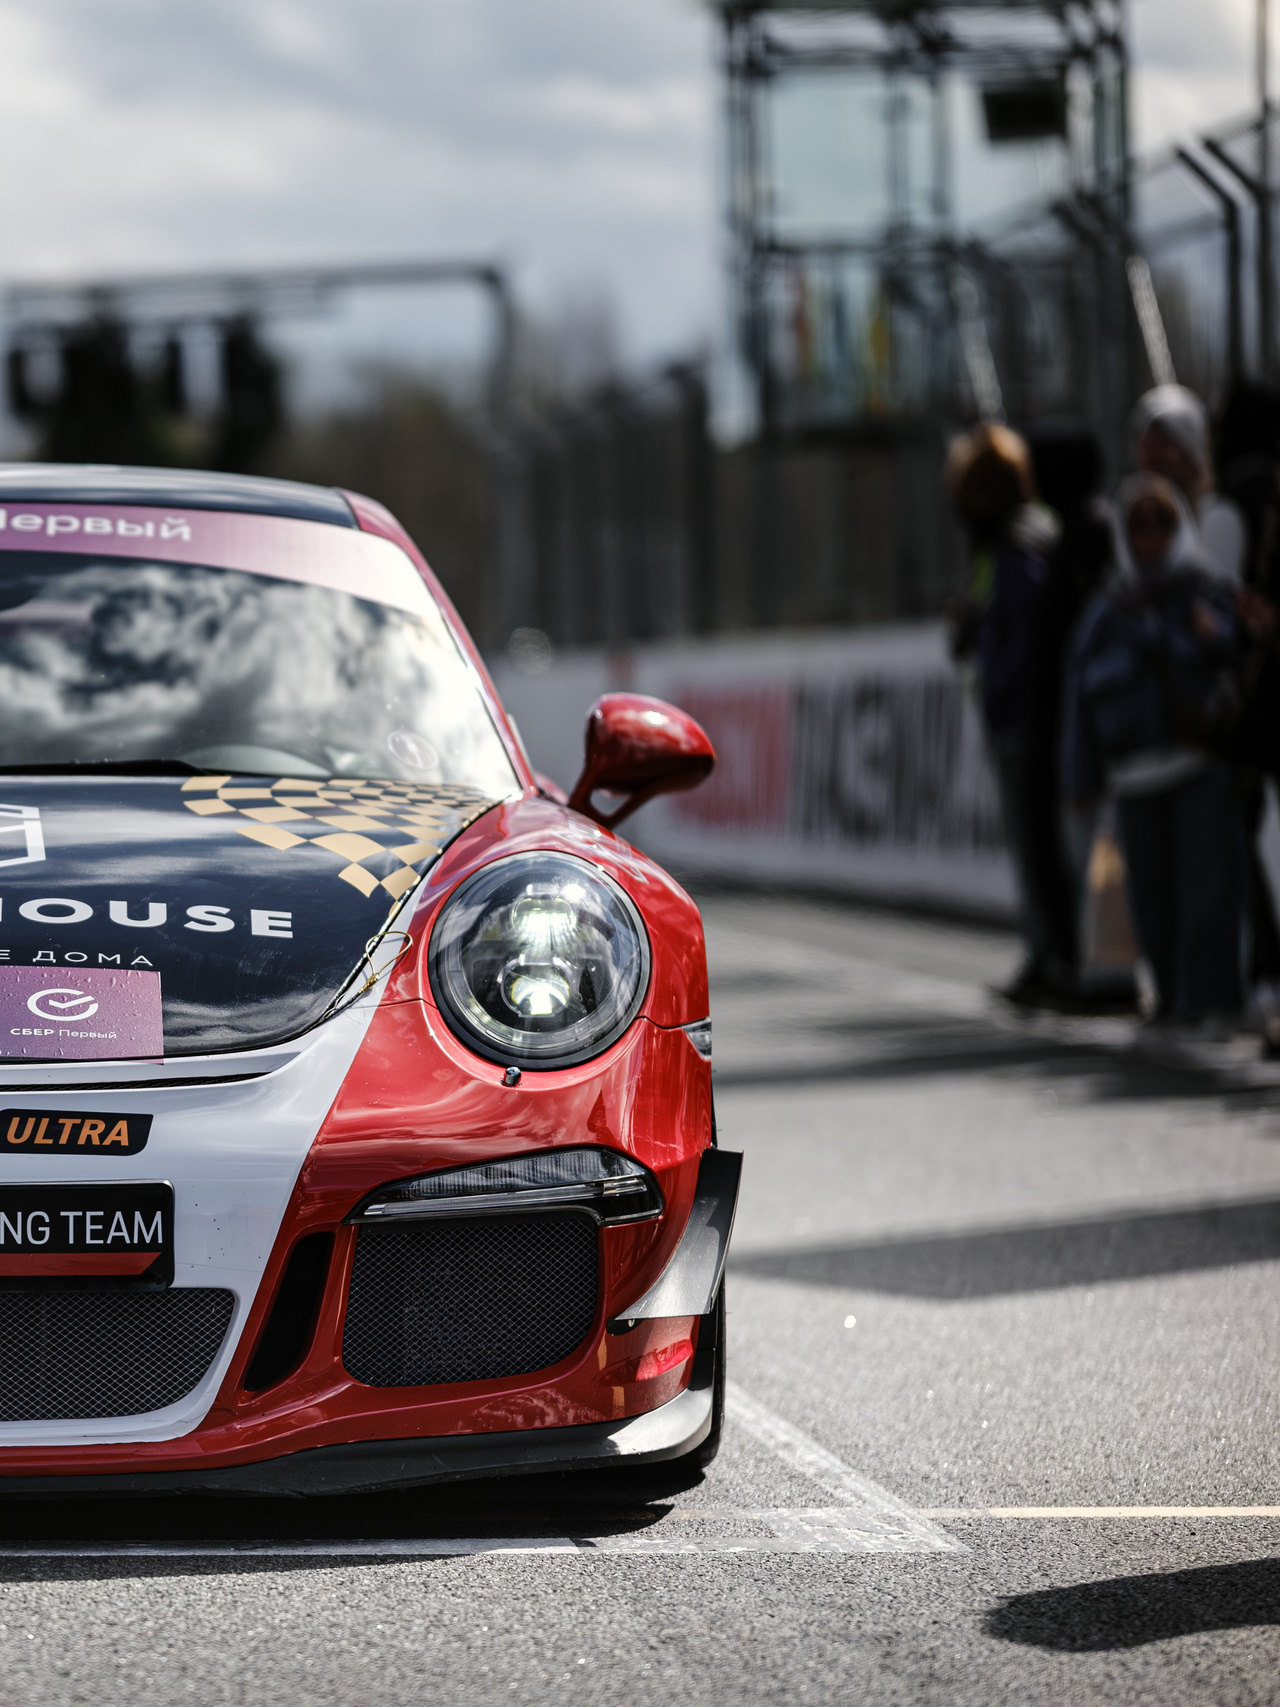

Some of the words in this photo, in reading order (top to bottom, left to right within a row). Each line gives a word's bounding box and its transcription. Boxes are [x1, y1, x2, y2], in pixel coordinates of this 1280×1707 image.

[32, 950, 154, 967] ДОМА
[10, 1028, 54, 1036] СБЕР
[59, 1029, 117, 1039] Первый
[6, 1116, 129, 1146] ULTRA
[60, 1210, 163, 1244] TEAM
